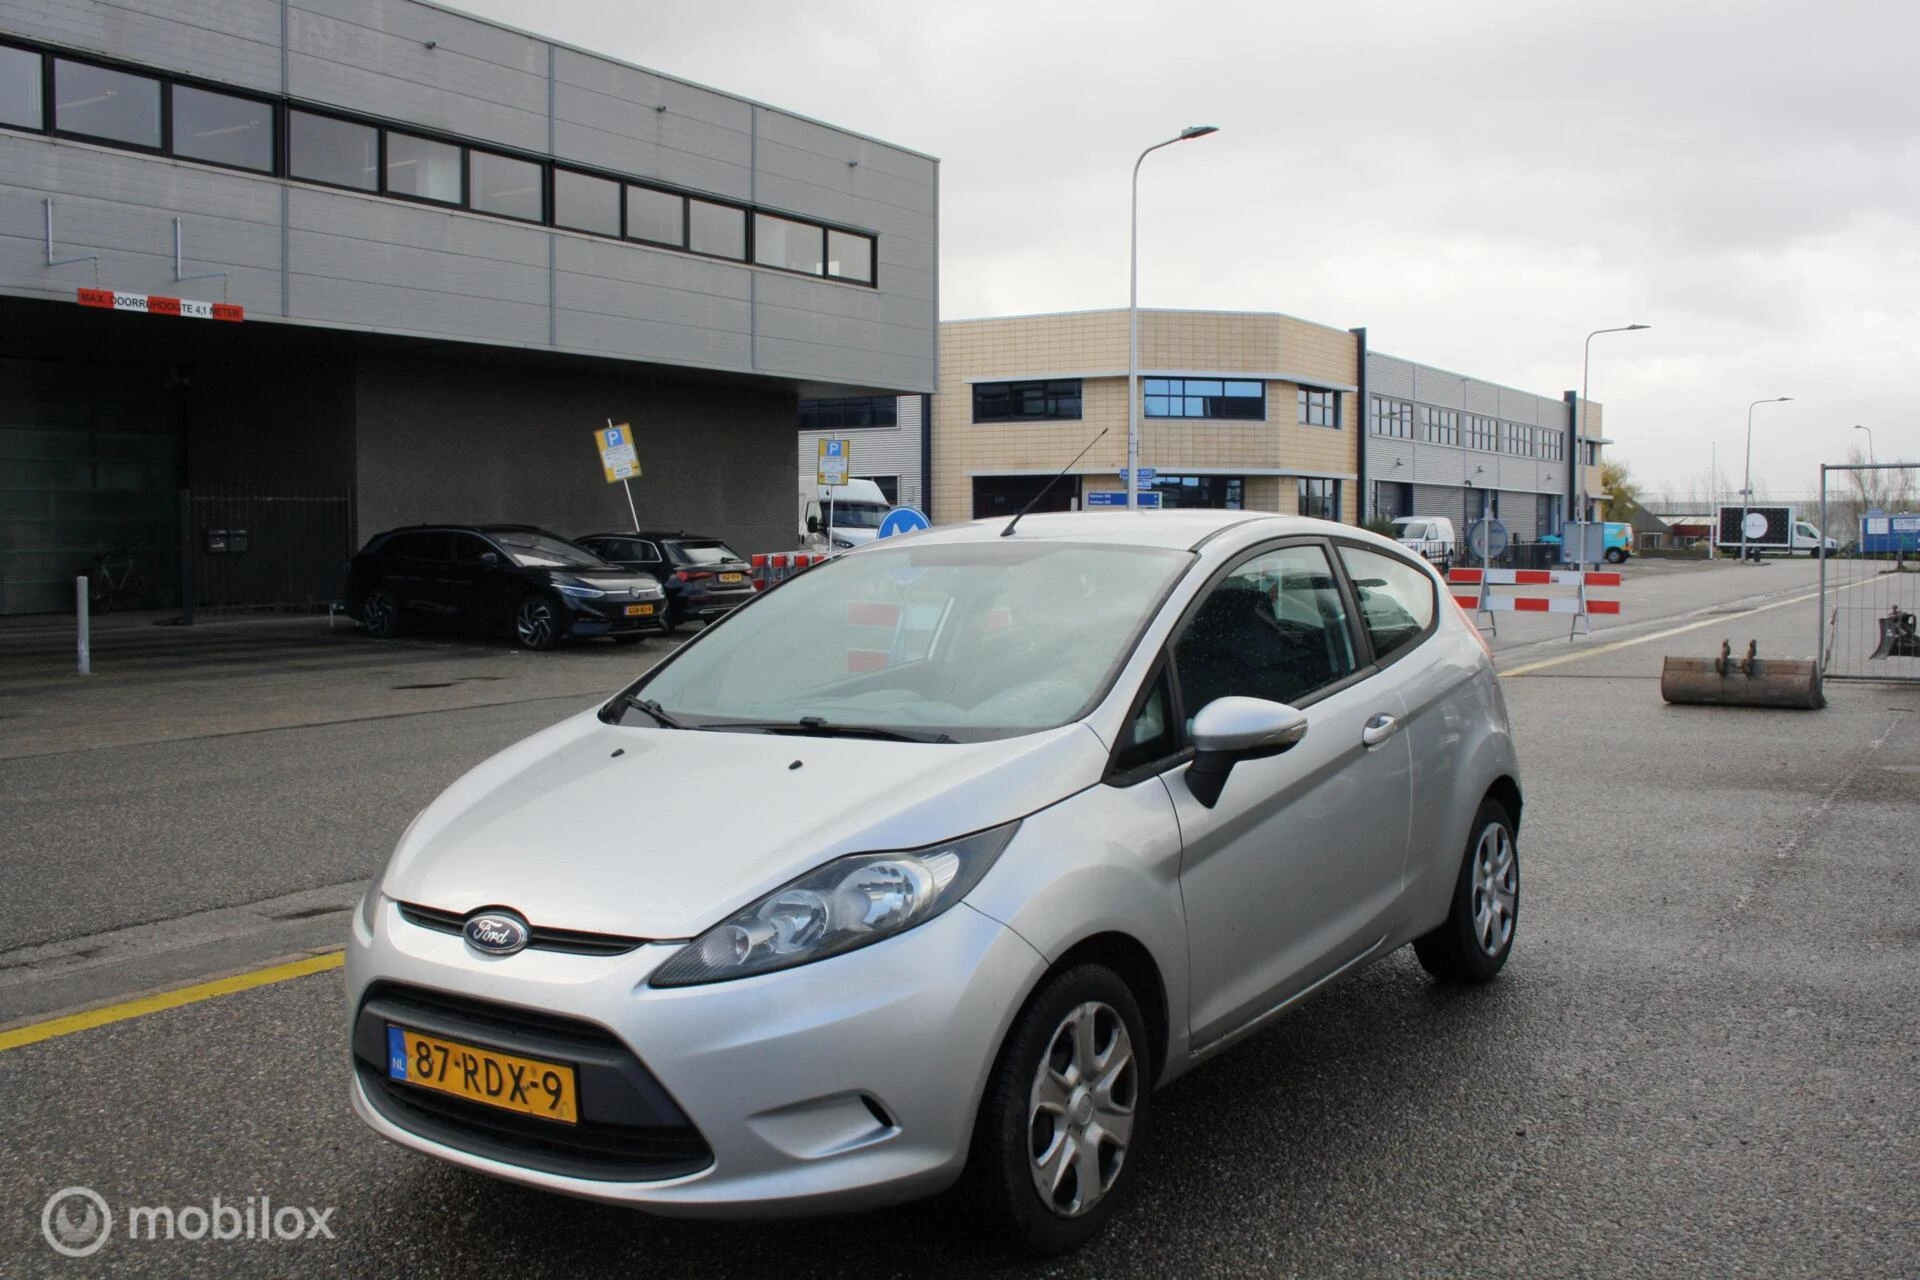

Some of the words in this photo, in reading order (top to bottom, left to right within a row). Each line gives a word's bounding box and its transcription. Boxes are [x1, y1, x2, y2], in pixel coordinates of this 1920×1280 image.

[210, 307, 240, 318] METER
[607, 430, 618, 446] P
[830, 442, 839, 455] P
[473, 919, 510, 945] Ford
[392, 1056, 405, 1071] NL
[415, 1040, 562, 1111] 87-RDX-9
